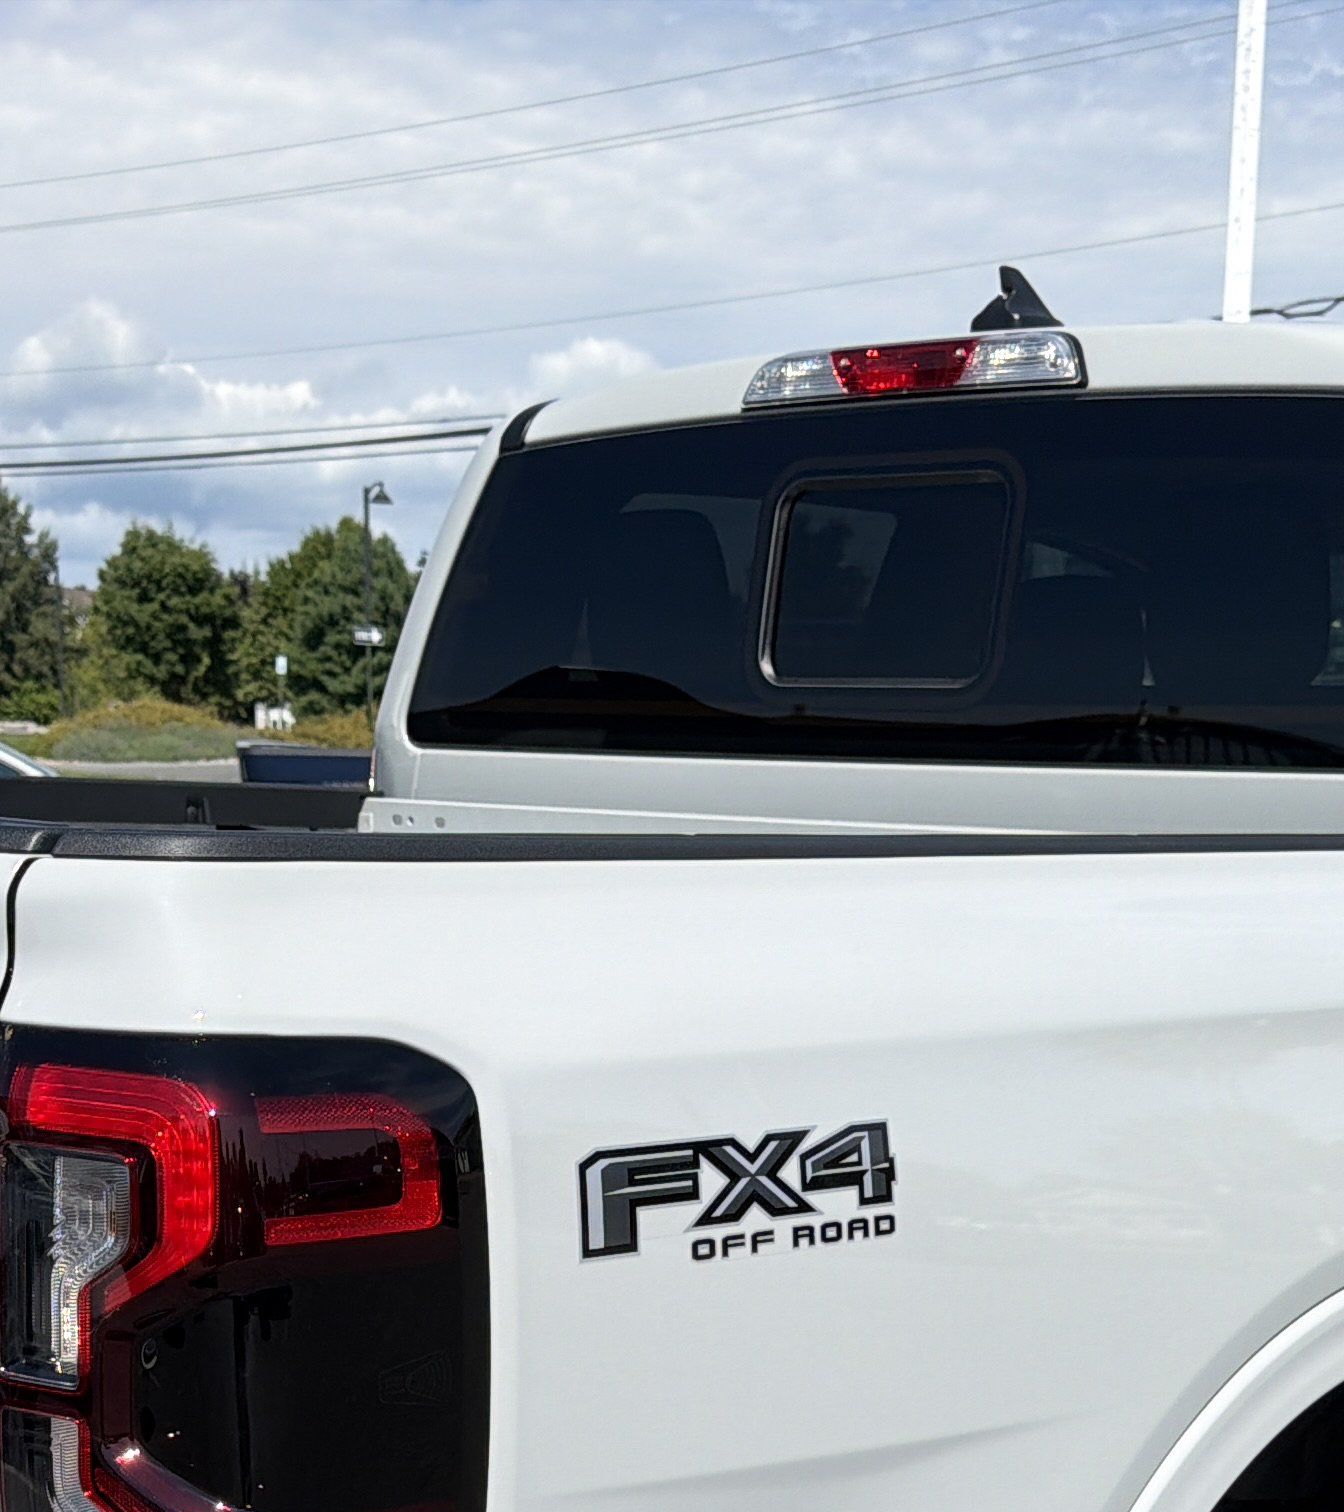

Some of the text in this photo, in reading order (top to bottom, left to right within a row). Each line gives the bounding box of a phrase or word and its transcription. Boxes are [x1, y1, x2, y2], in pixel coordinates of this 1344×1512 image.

[577, 1119, 896, 1262] FX4
[690, 1213, 897, 1262] OFF ROAD
